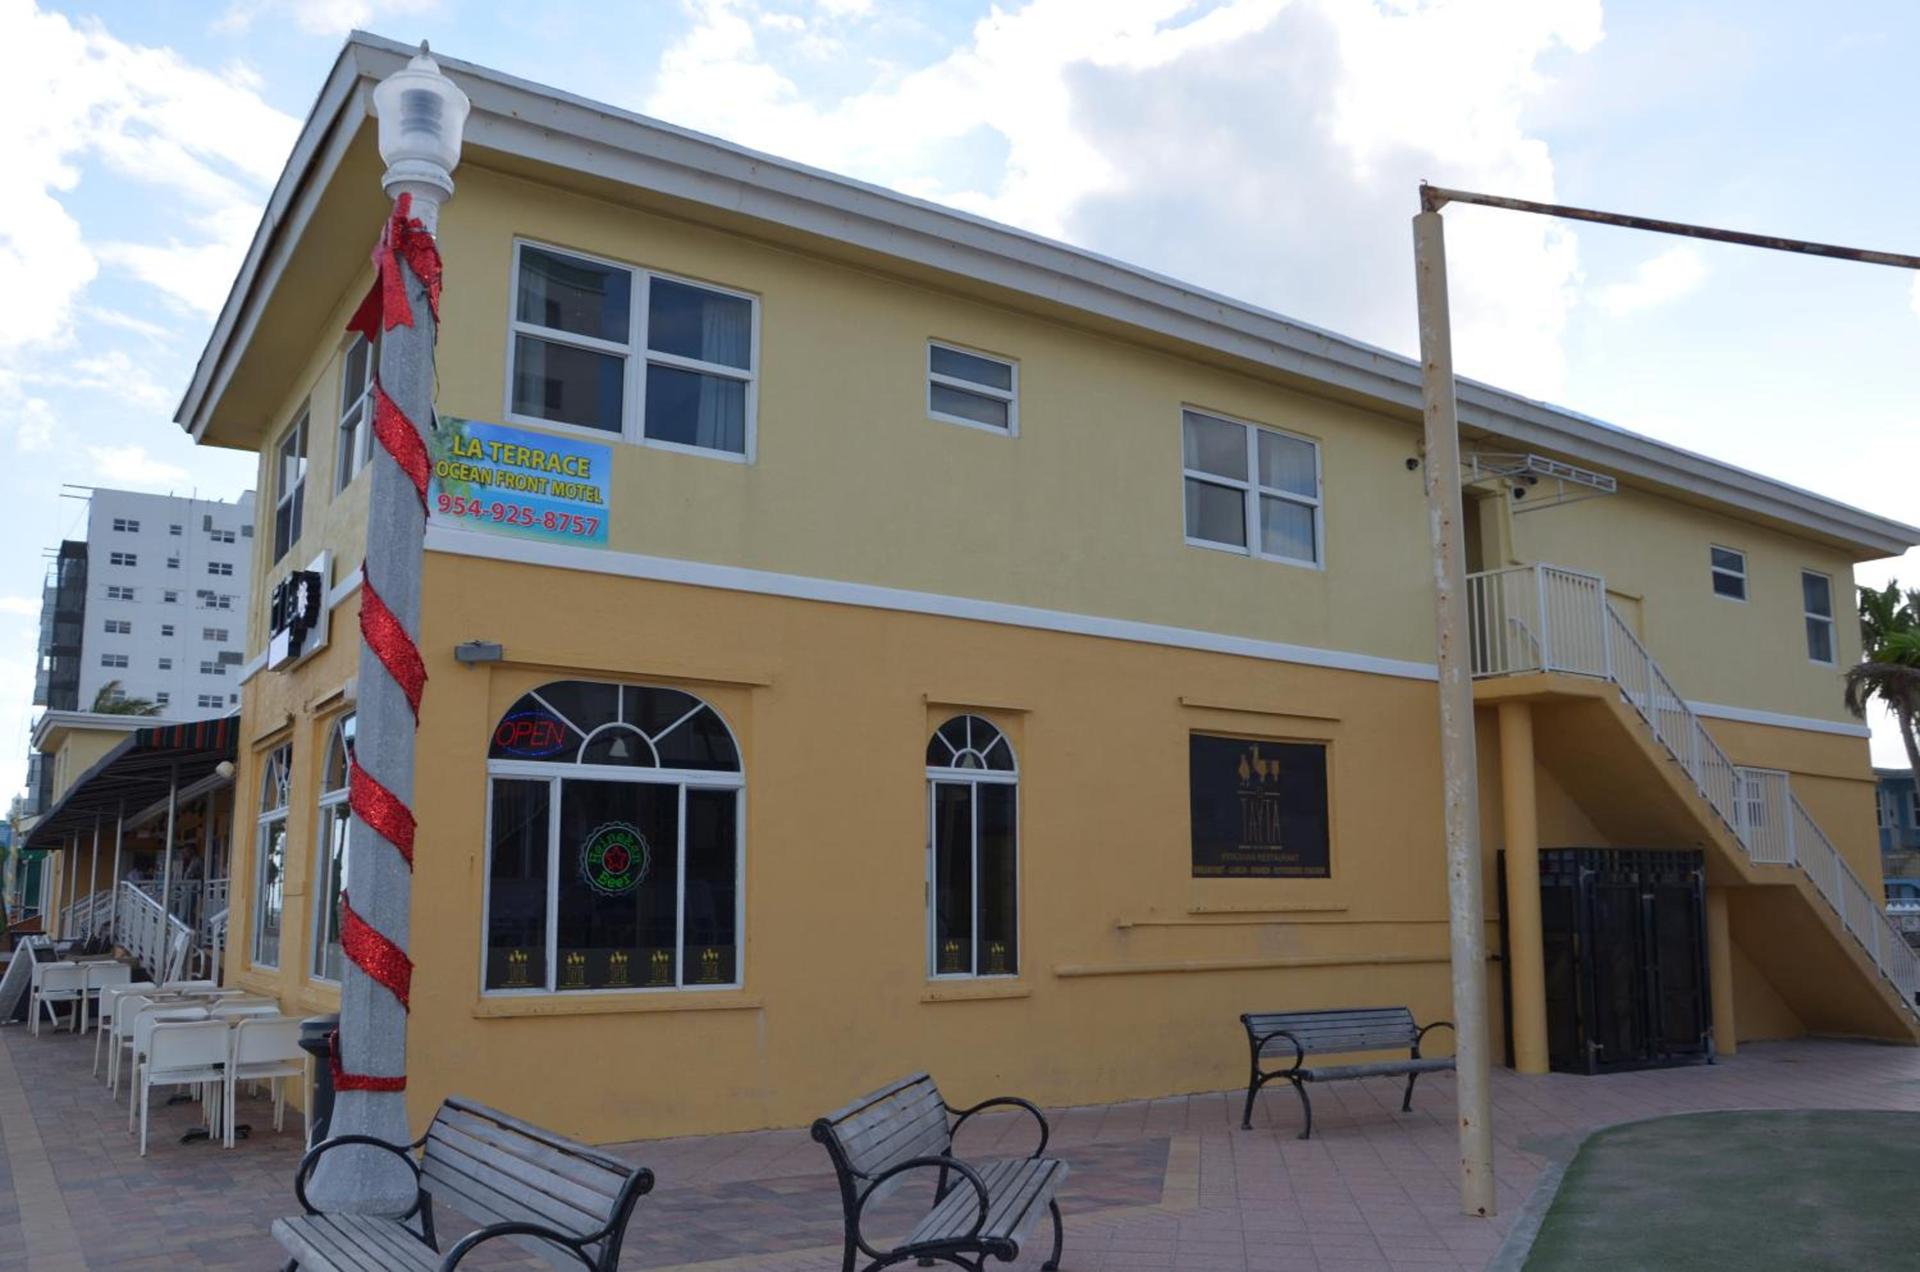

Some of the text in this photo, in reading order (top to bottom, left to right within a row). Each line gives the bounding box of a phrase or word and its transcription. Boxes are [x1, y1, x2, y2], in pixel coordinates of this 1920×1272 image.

[453, 434, 591, 478] LA TERRACE
[436, 460, 603, 504] OCEAN FRONT MOTEL
[437, 493, 601, 537] 954-925-8757
[495, 719, 567, 748] OPEN
[588, 831, 641, 864] Heineken
[597, 871, 632, 888] Beer
